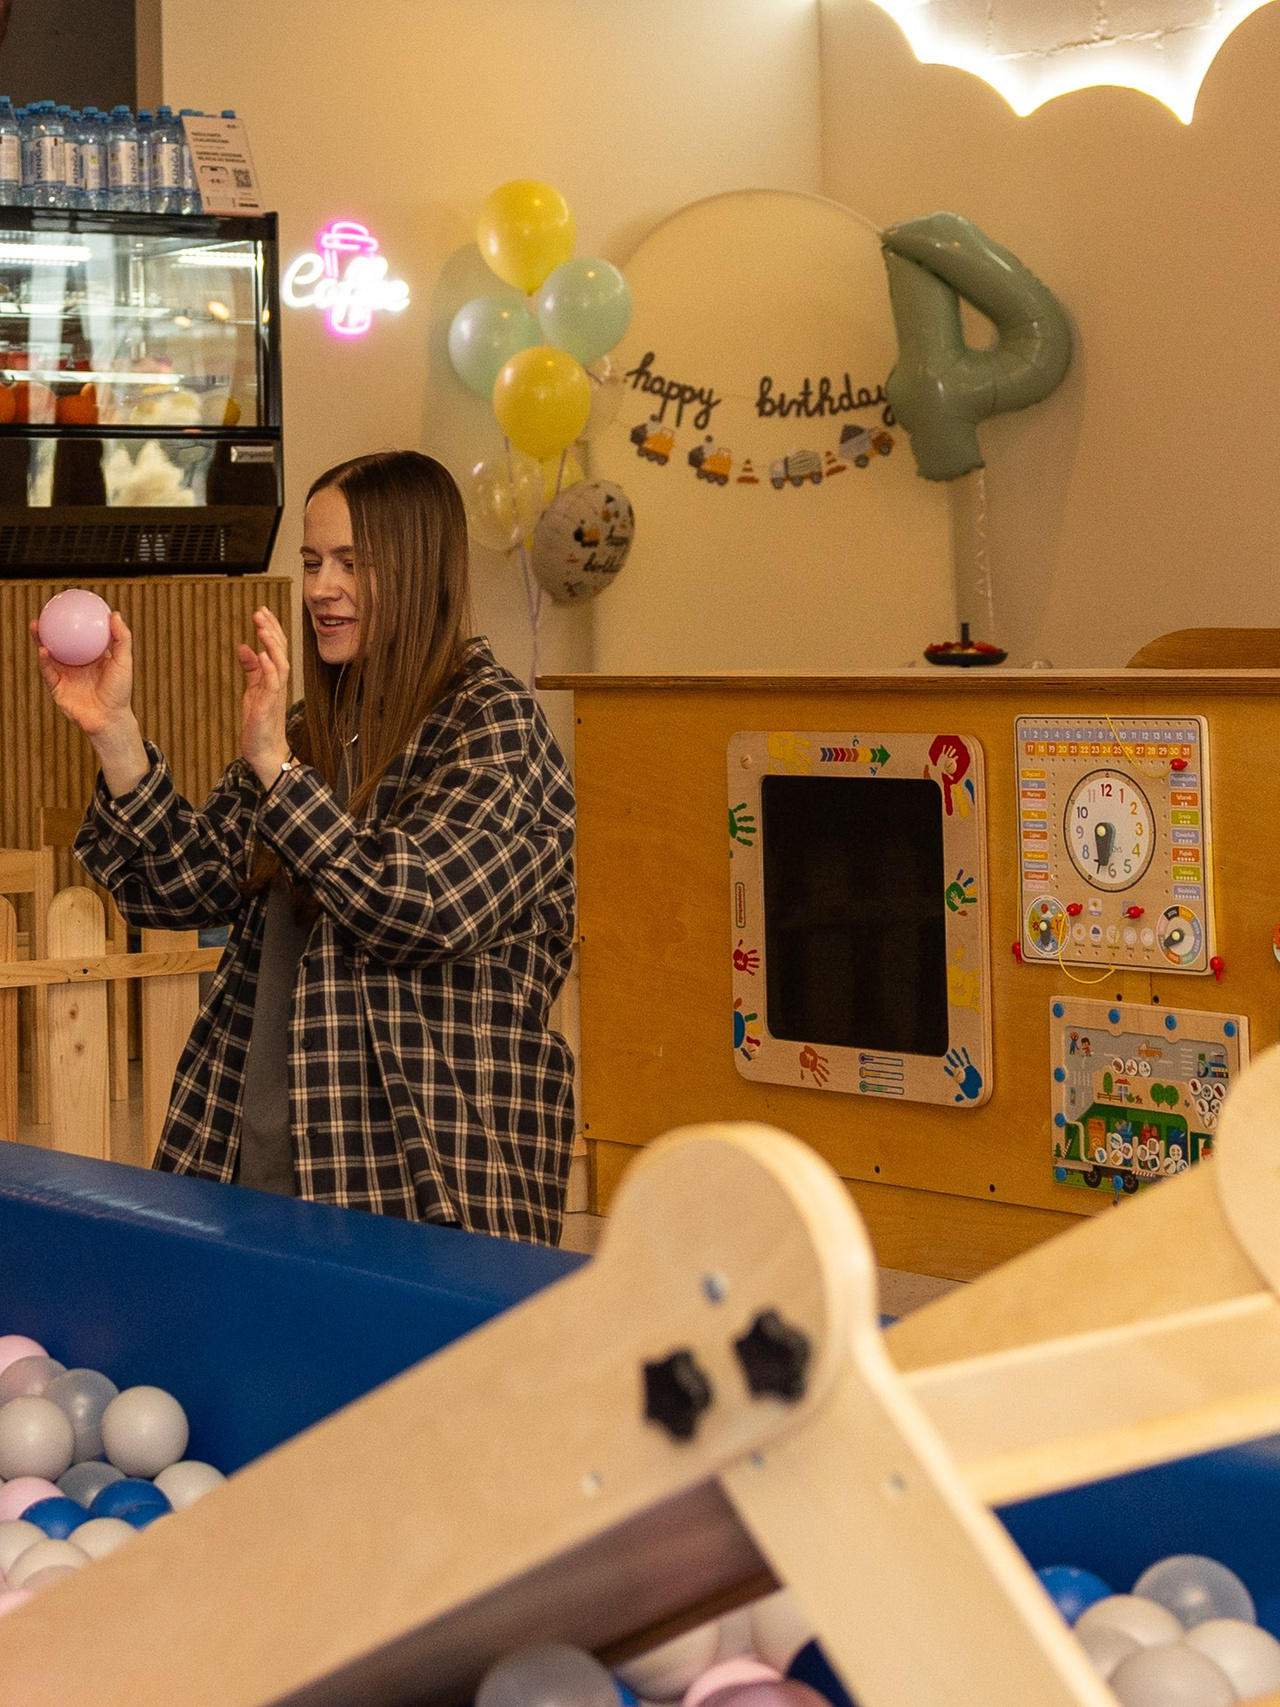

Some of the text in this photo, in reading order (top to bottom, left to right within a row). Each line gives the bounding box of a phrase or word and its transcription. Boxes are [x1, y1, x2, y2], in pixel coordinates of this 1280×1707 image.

[35, 139, 44, 179] KINGA
[172, 146, 182, 184] KINGA
[626, 352, 721, 430] happy
[1049, 745, 1055, 753] 19
[1059, 745, 1067, 753] 20
[1070, 745, 1077, 753] 21
[1113, 746, 1122, 754] 25
[1158, 747, 1167, 755] 29
[1170, 747, 1178, 755] 30
[1087, 789, 1096, 803] 11
[1101, 784, 1112, 797] 12
[1120, 788, 1124, 803] 1
[1076, 806, 1088, 819] 10
[1130, 802, 1138, 815] 2
[1076, 825, 1084, 839] 9
[1135, 822, 1143, 836] 3
[1082, 844, 1090, 859] 8
[1132, 843, 1141, 857] 4
[1093, 859, 1101, 874] 7
[1108, 863, 1117, 878] 6
[1123, 859, 1132, 873] 5
